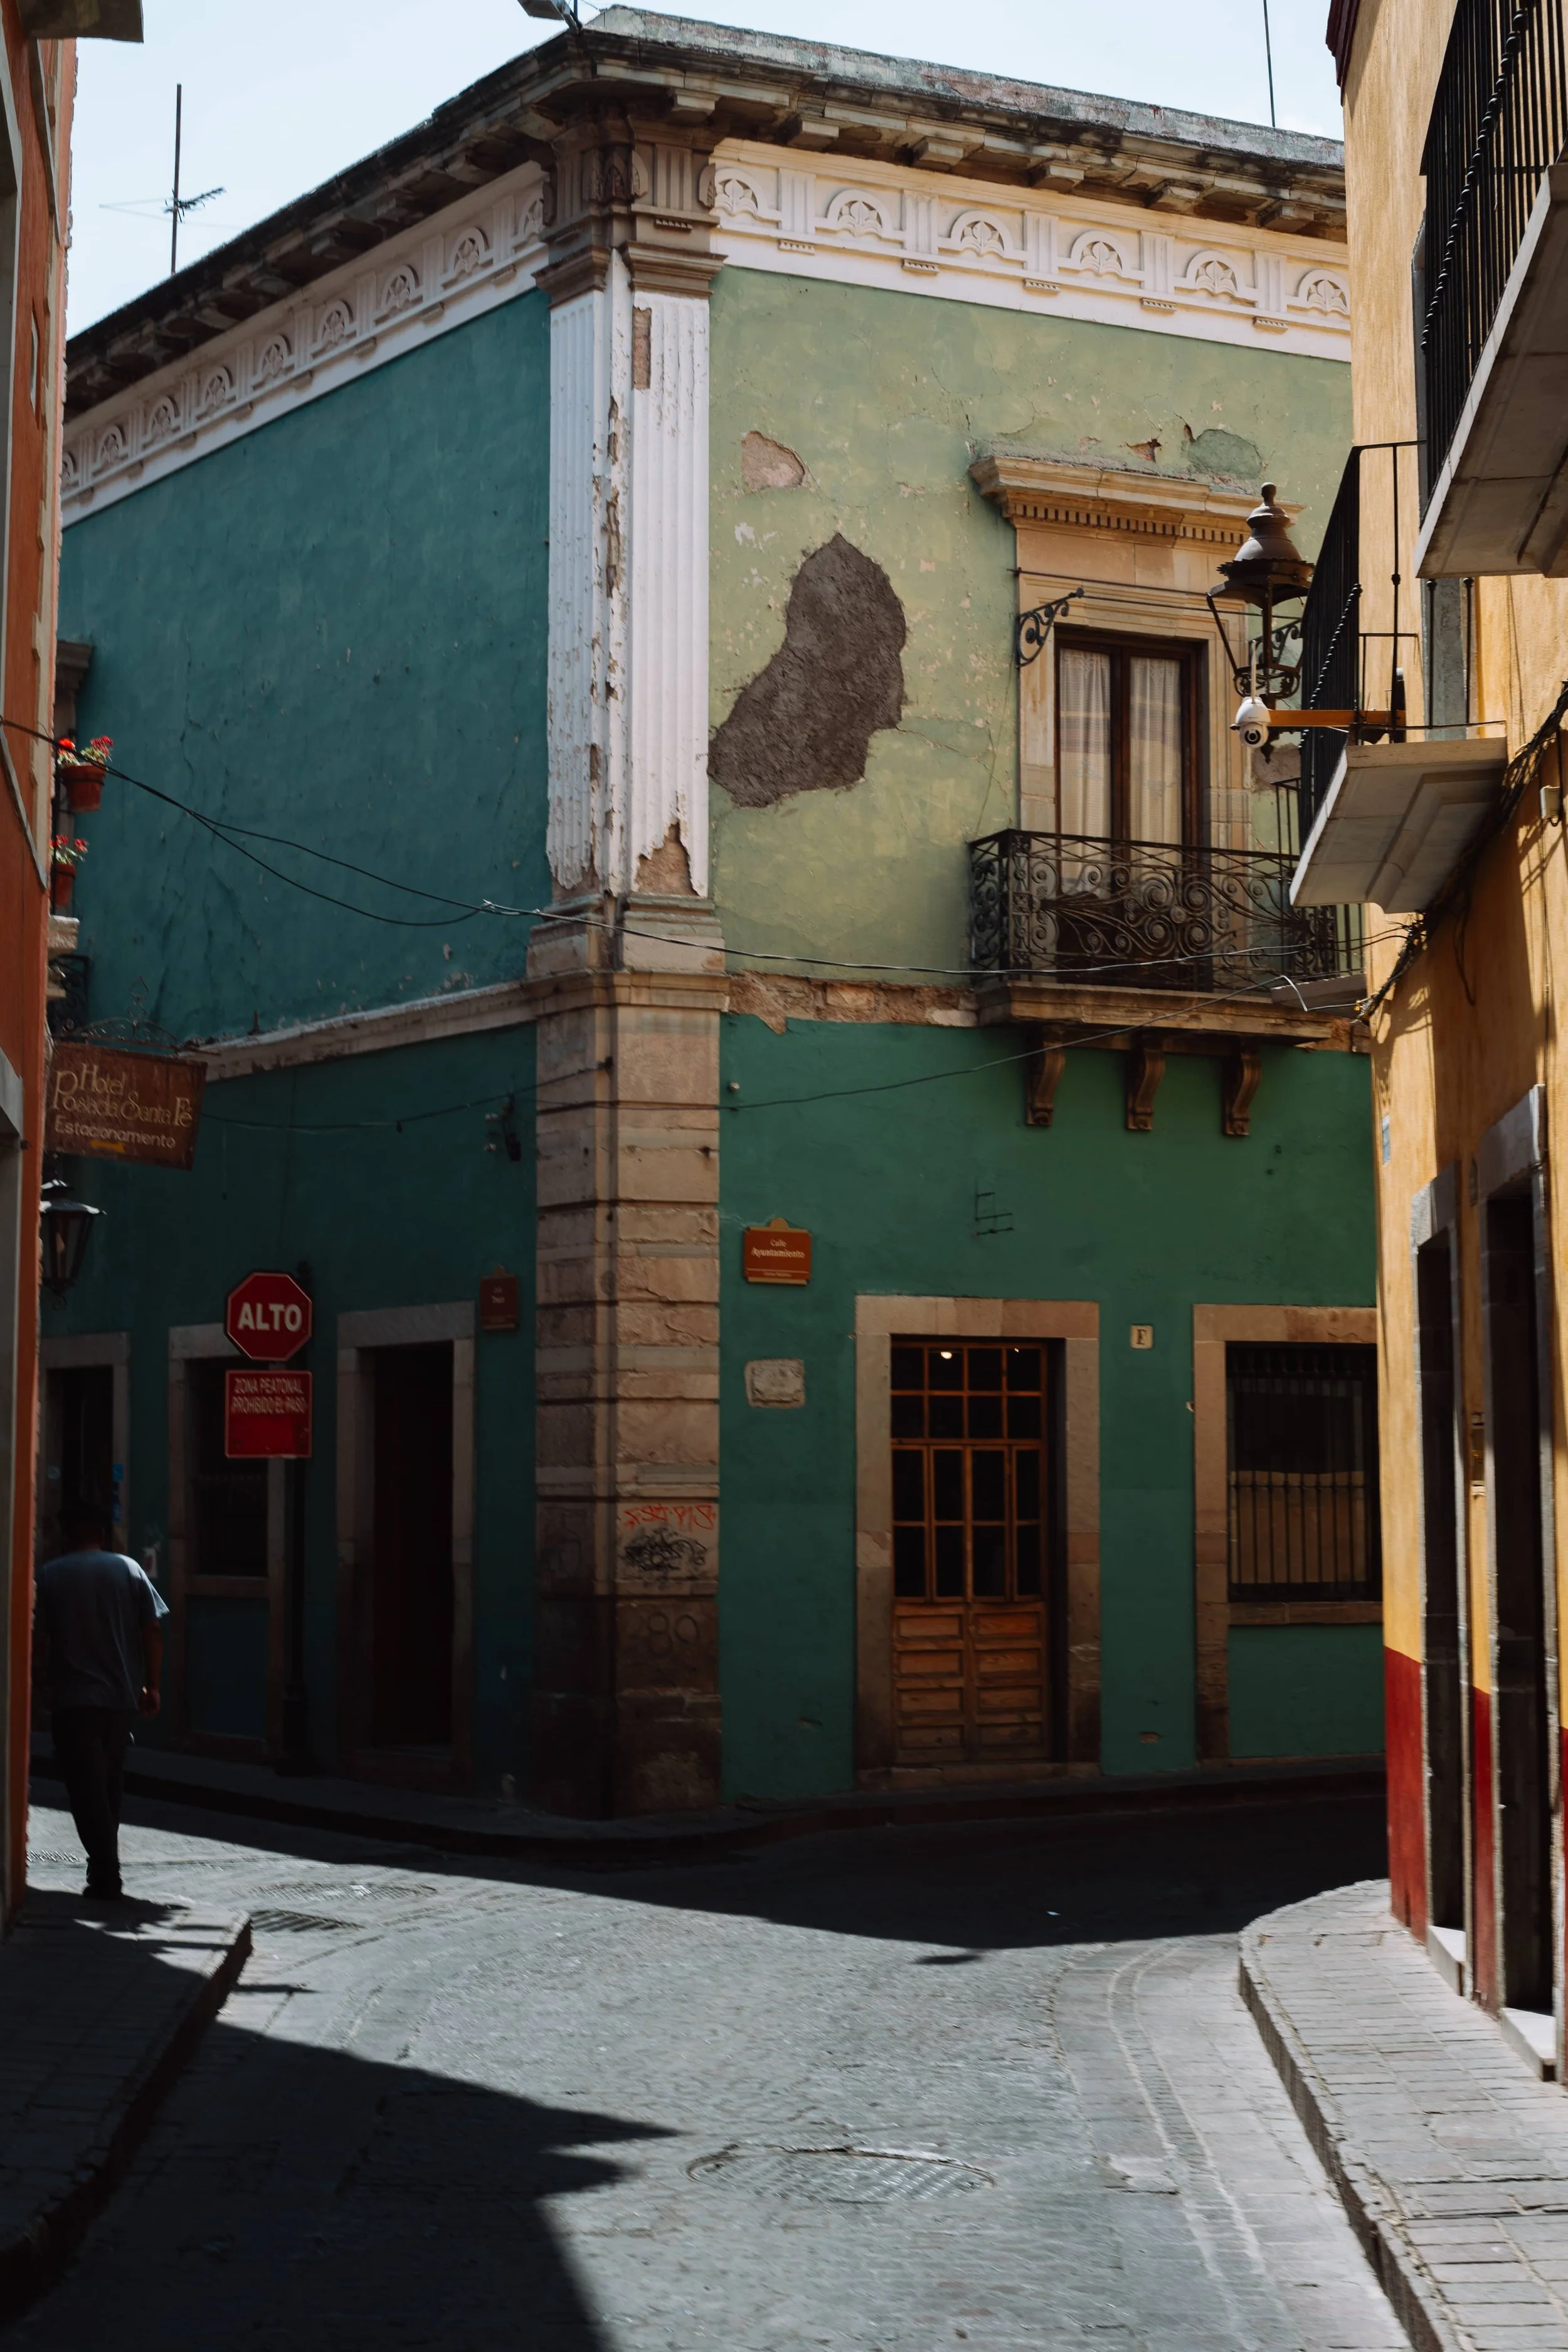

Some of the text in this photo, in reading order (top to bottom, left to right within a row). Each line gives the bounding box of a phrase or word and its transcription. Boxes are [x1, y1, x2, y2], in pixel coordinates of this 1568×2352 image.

[80, 1062, 125, 1096] Hotel
[51, 1070, 119, 1118] Posada
[120, 1091, 171, 1125] Santa
[55, 1115, 176, 1149] Estacionamiento
[751, 1246, 805, 1259] Ayuntamiento
[770, 1238, 788, 1248] Calle
[238, 1301, 302, 1332] ALTO
[234, 1377, 304, 1394] ZONA PEATONAL
[231, 1396, 273, 1414] PROHIBIDO
